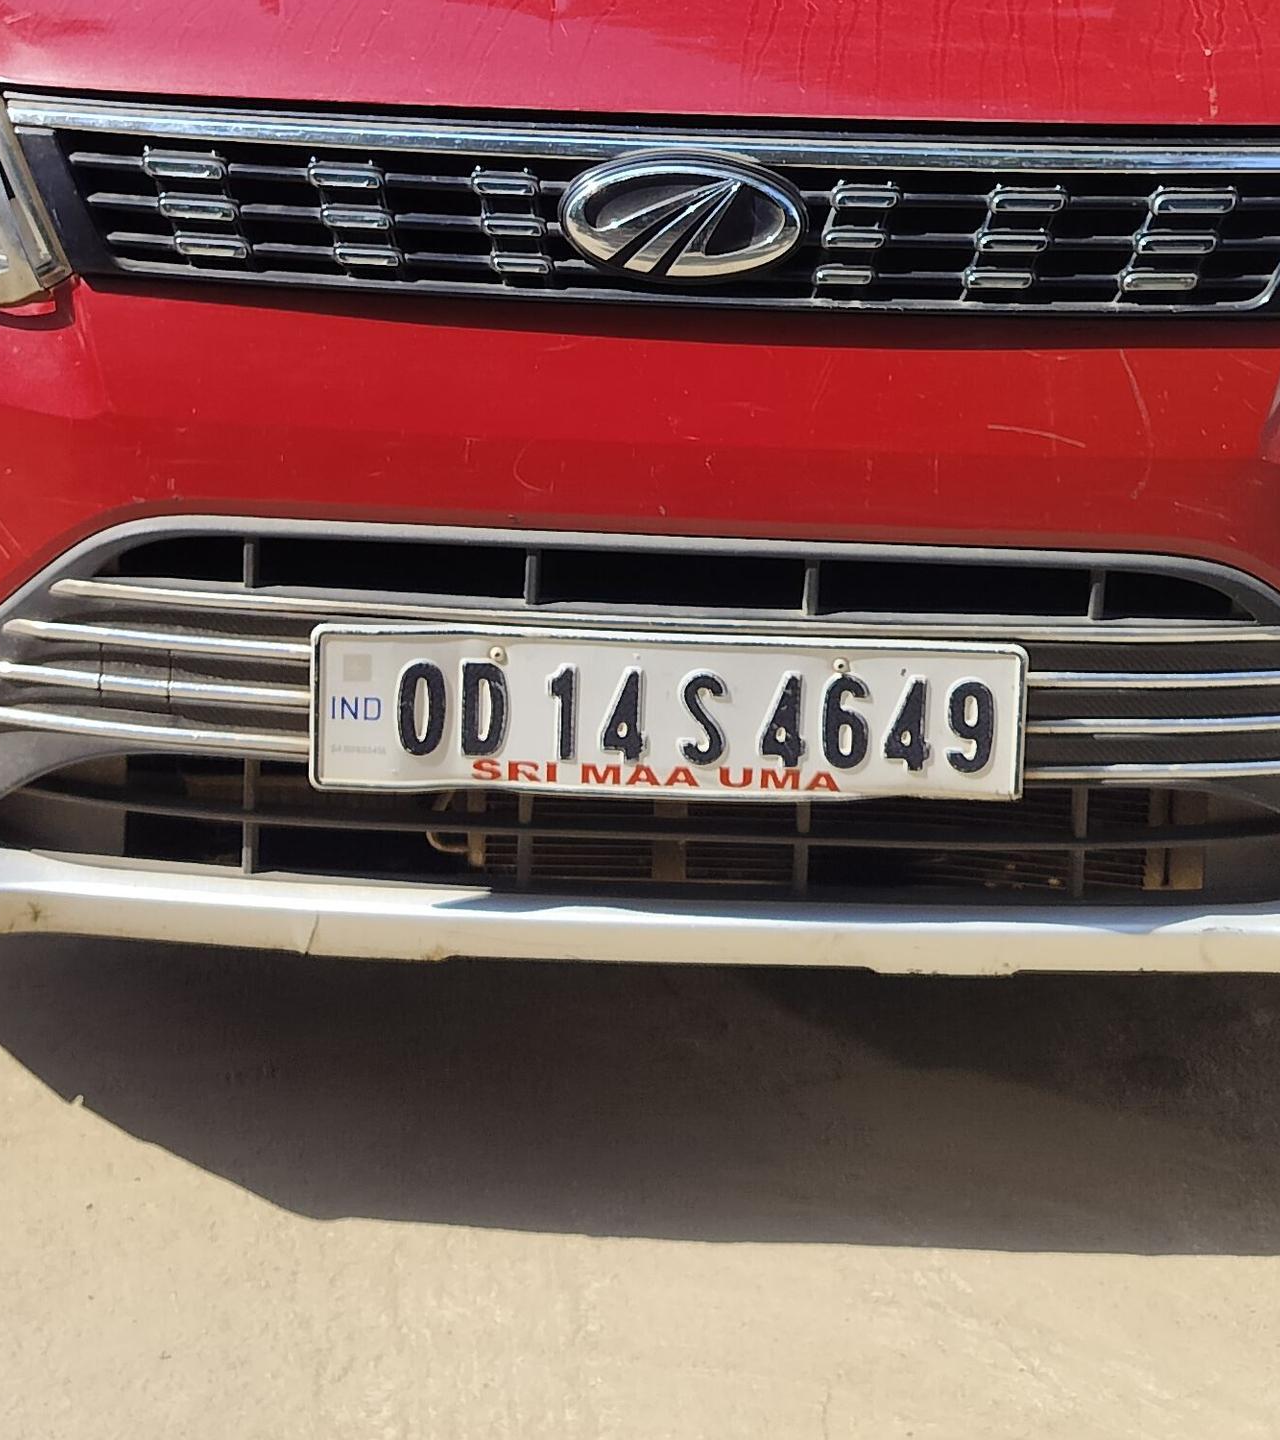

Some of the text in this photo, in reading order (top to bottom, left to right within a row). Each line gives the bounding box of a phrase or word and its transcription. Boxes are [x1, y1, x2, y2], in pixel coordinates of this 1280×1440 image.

[330, 695, 382, 721] IND
[548, 664, 646, 764] 14
[679, 671, 728, 765] S
[758, 673, 995, 774] 4649
[472, 759, 841, 793] SRI MAA UMA
